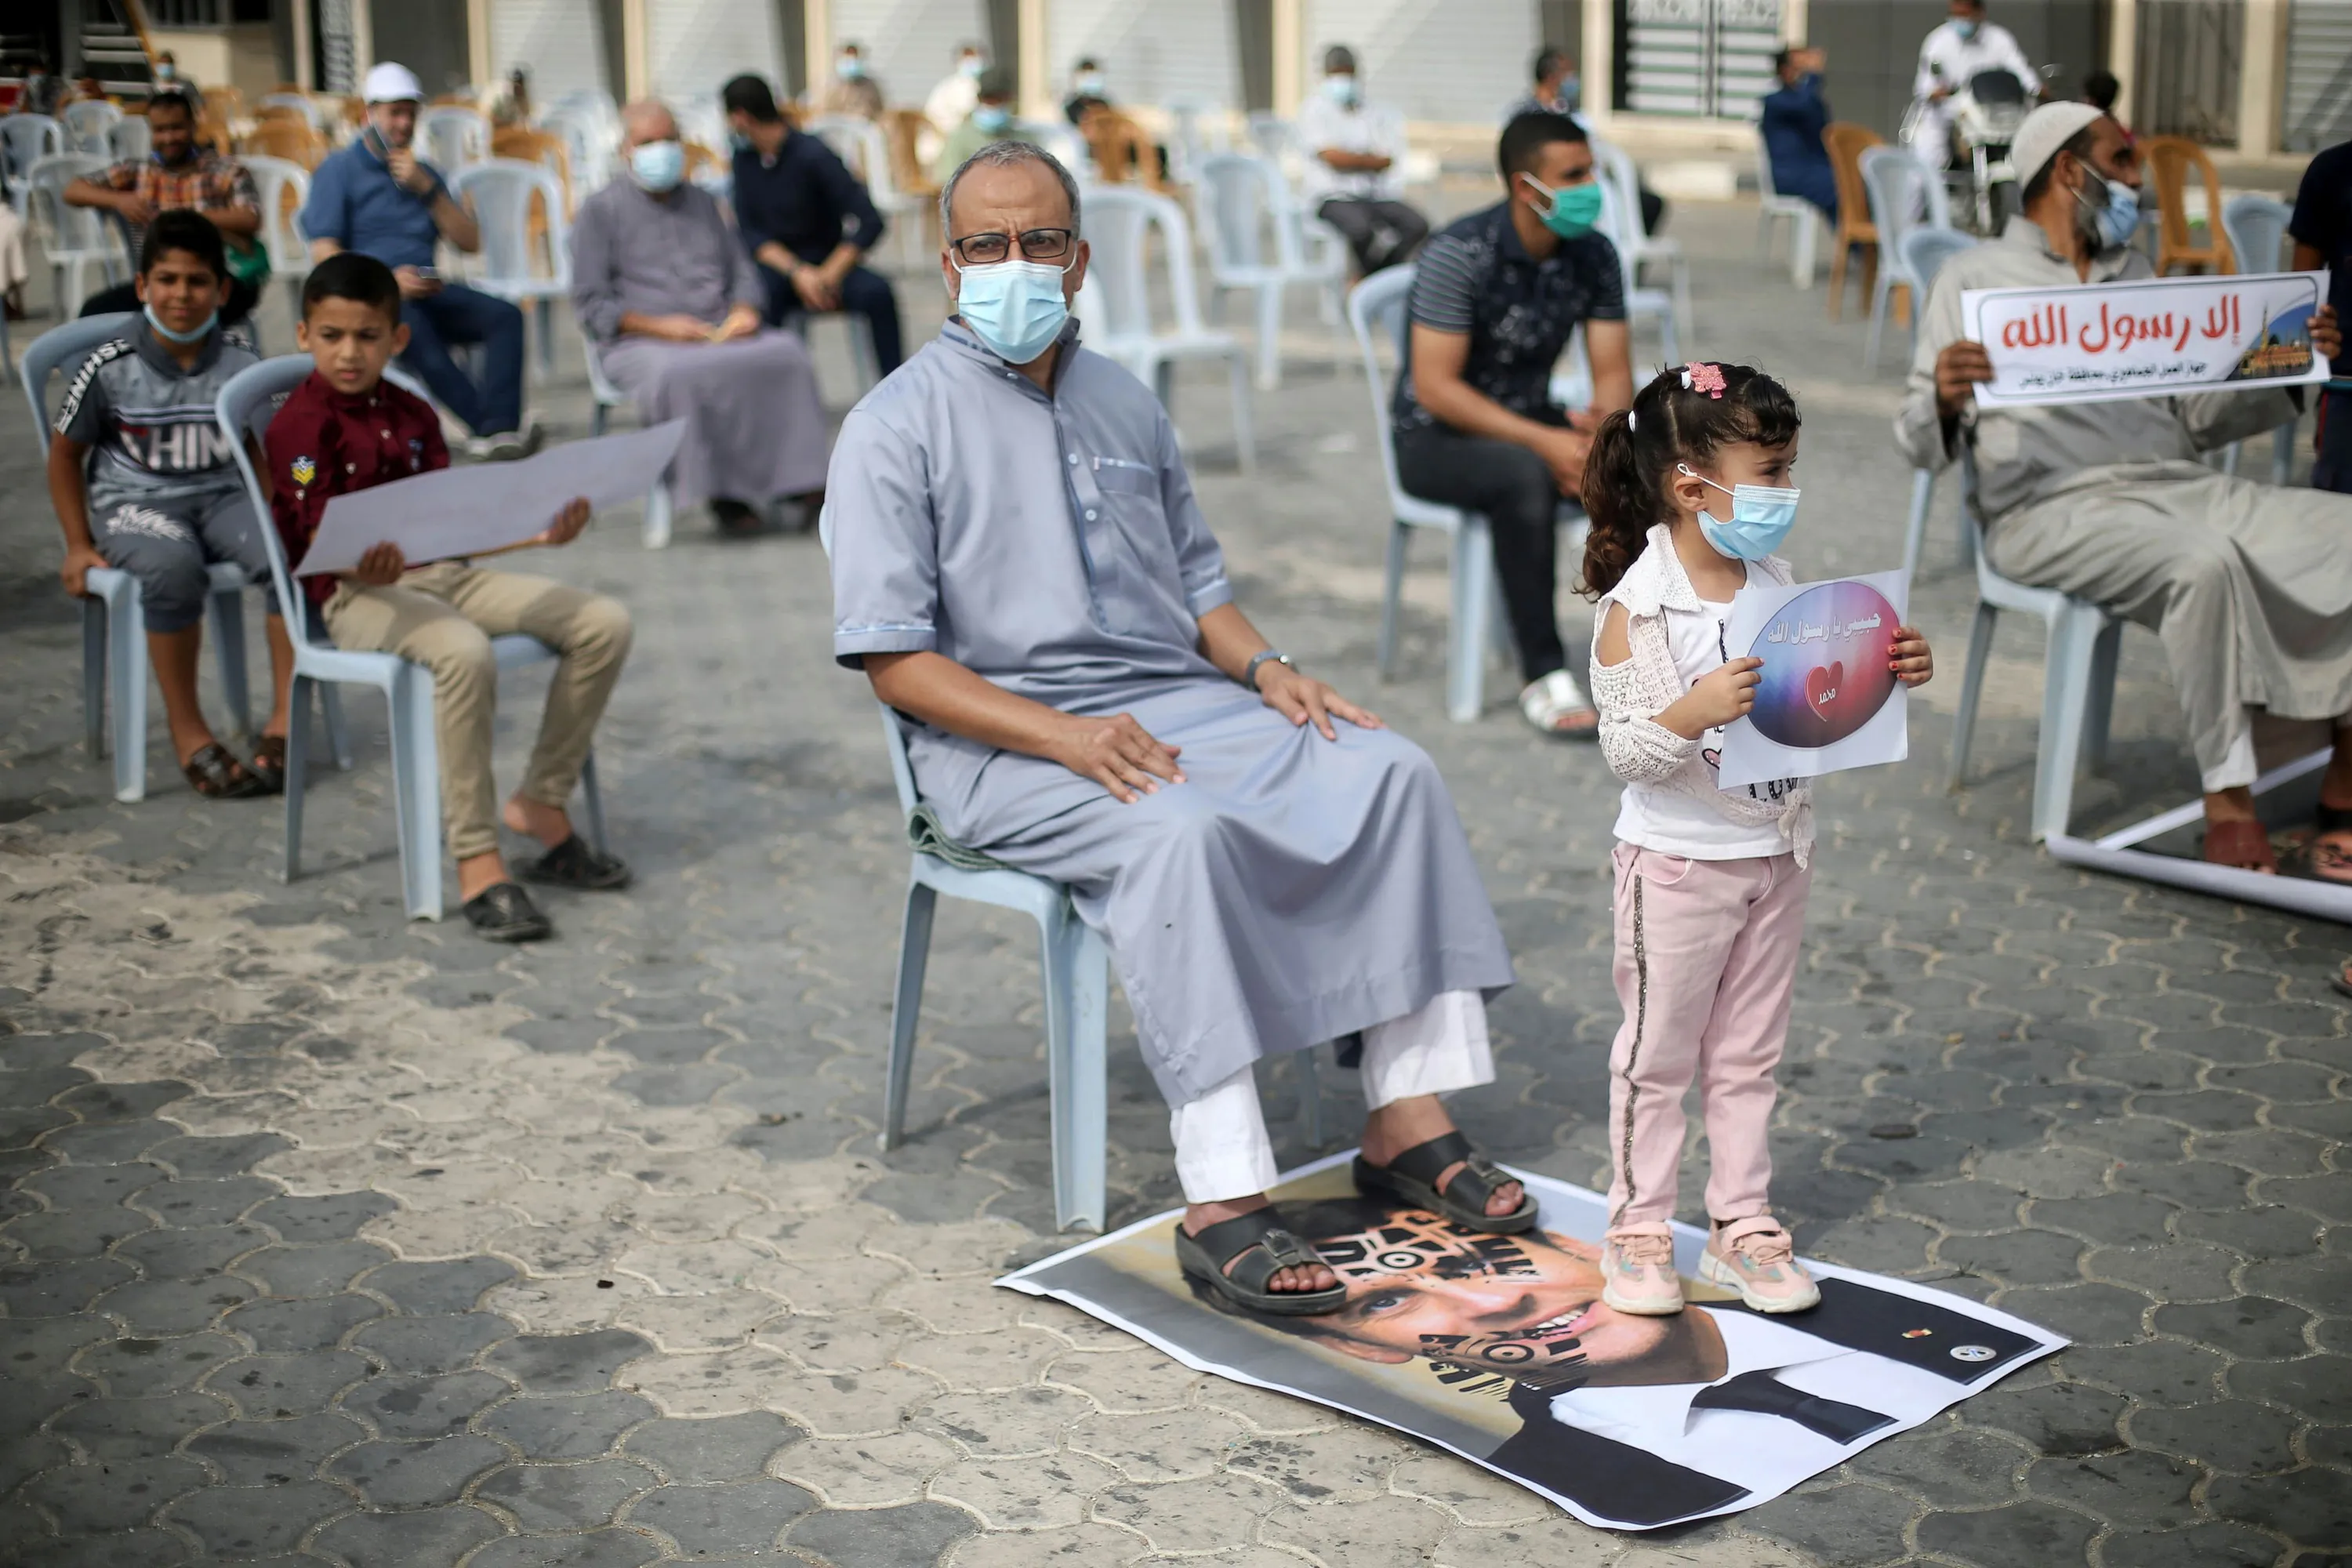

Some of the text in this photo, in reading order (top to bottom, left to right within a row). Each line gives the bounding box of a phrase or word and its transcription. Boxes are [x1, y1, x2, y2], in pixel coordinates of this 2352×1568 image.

[2002, 301, 2068, 347] الله
[2079, 301, 2192, 353] رسول
[1767, 612, 1882, 644] حبيبي يا رسول الله
